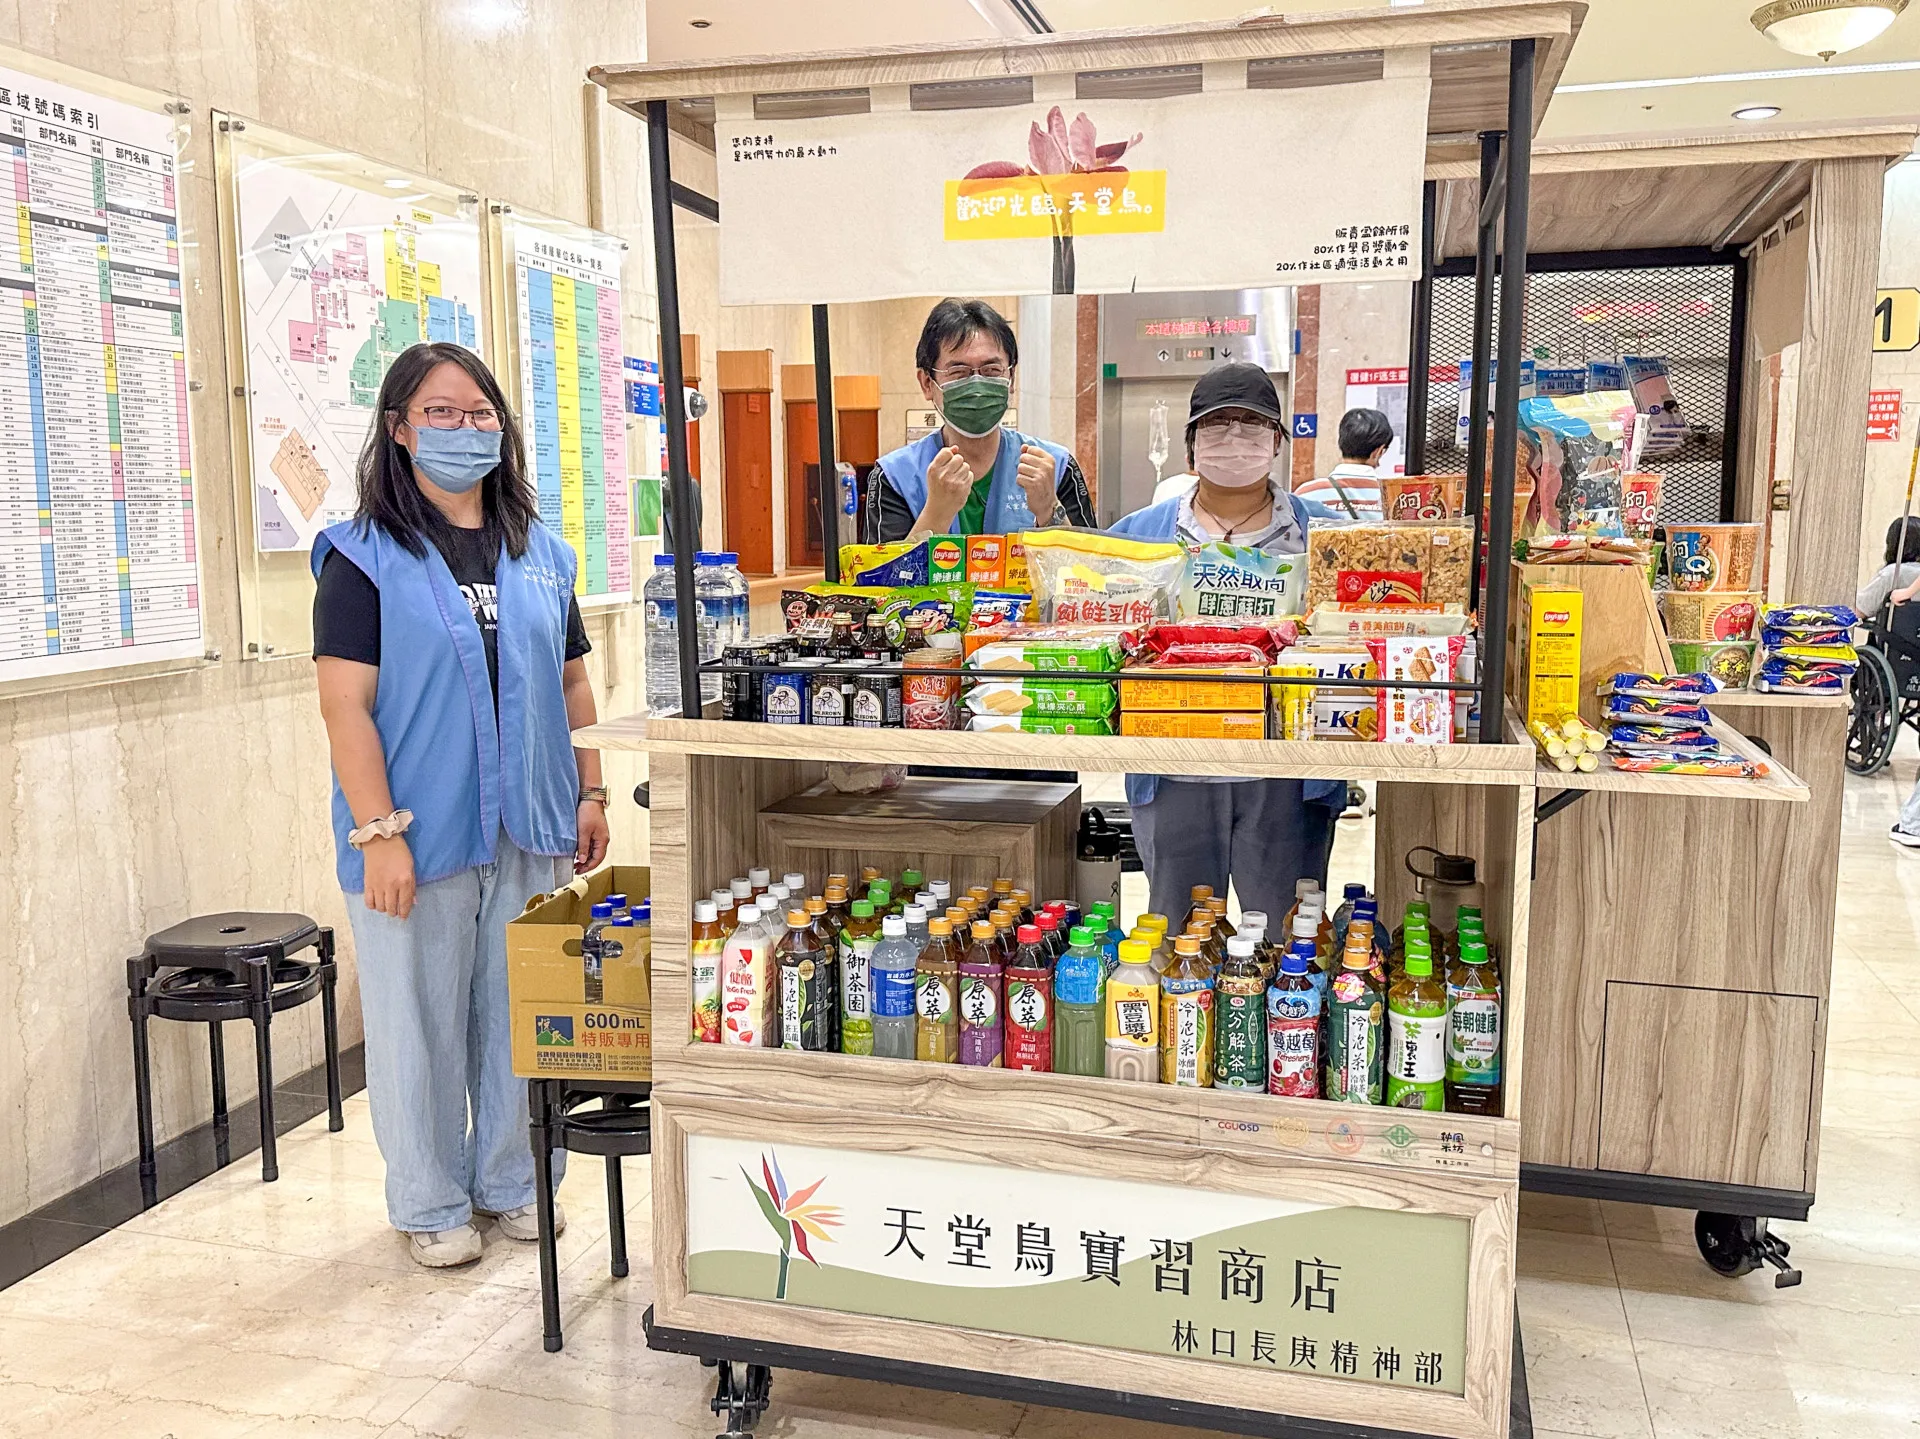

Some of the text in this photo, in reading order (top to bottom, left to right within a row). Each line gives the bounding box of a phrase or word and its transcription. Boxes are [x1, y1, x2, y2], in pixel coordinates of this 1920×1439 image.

[39, 127, 77, 147] 部門名稱
[732, 135, 773, 148] 您的支持
[116, 148, 150, 166] 部門名稱
[1335, 225, 1409, 240] 販賣盈餘所得
[1193, 563, 1285, 593] 天然取向
[845, 954, 866, 1013] 御茶園
[919, 976, 941, 1024] 原萃
[584, 1013, 645, 1029] 600 mL
[964, 980, 987, 1029] 原萃
[1014, 984, 1037, 1032] 原萃
[1452, 1011, 1498, 1035] 每朝健康
[581, 1031, 650, 1048] 特販專用
[1178, 1002, 1196, 1056] 冷泡茶
[1227, 1011, 1246, 1073] 分解茶
[1351, 1015, 1368, 1071] 冷泡茶
[1218, 1122, 1260, 1133] CGUOSD
[883, 1206, 1343, 1315] 天堂鳥實習商店
[1172, 1319, 1445, 1387] 林口長庚精神部
